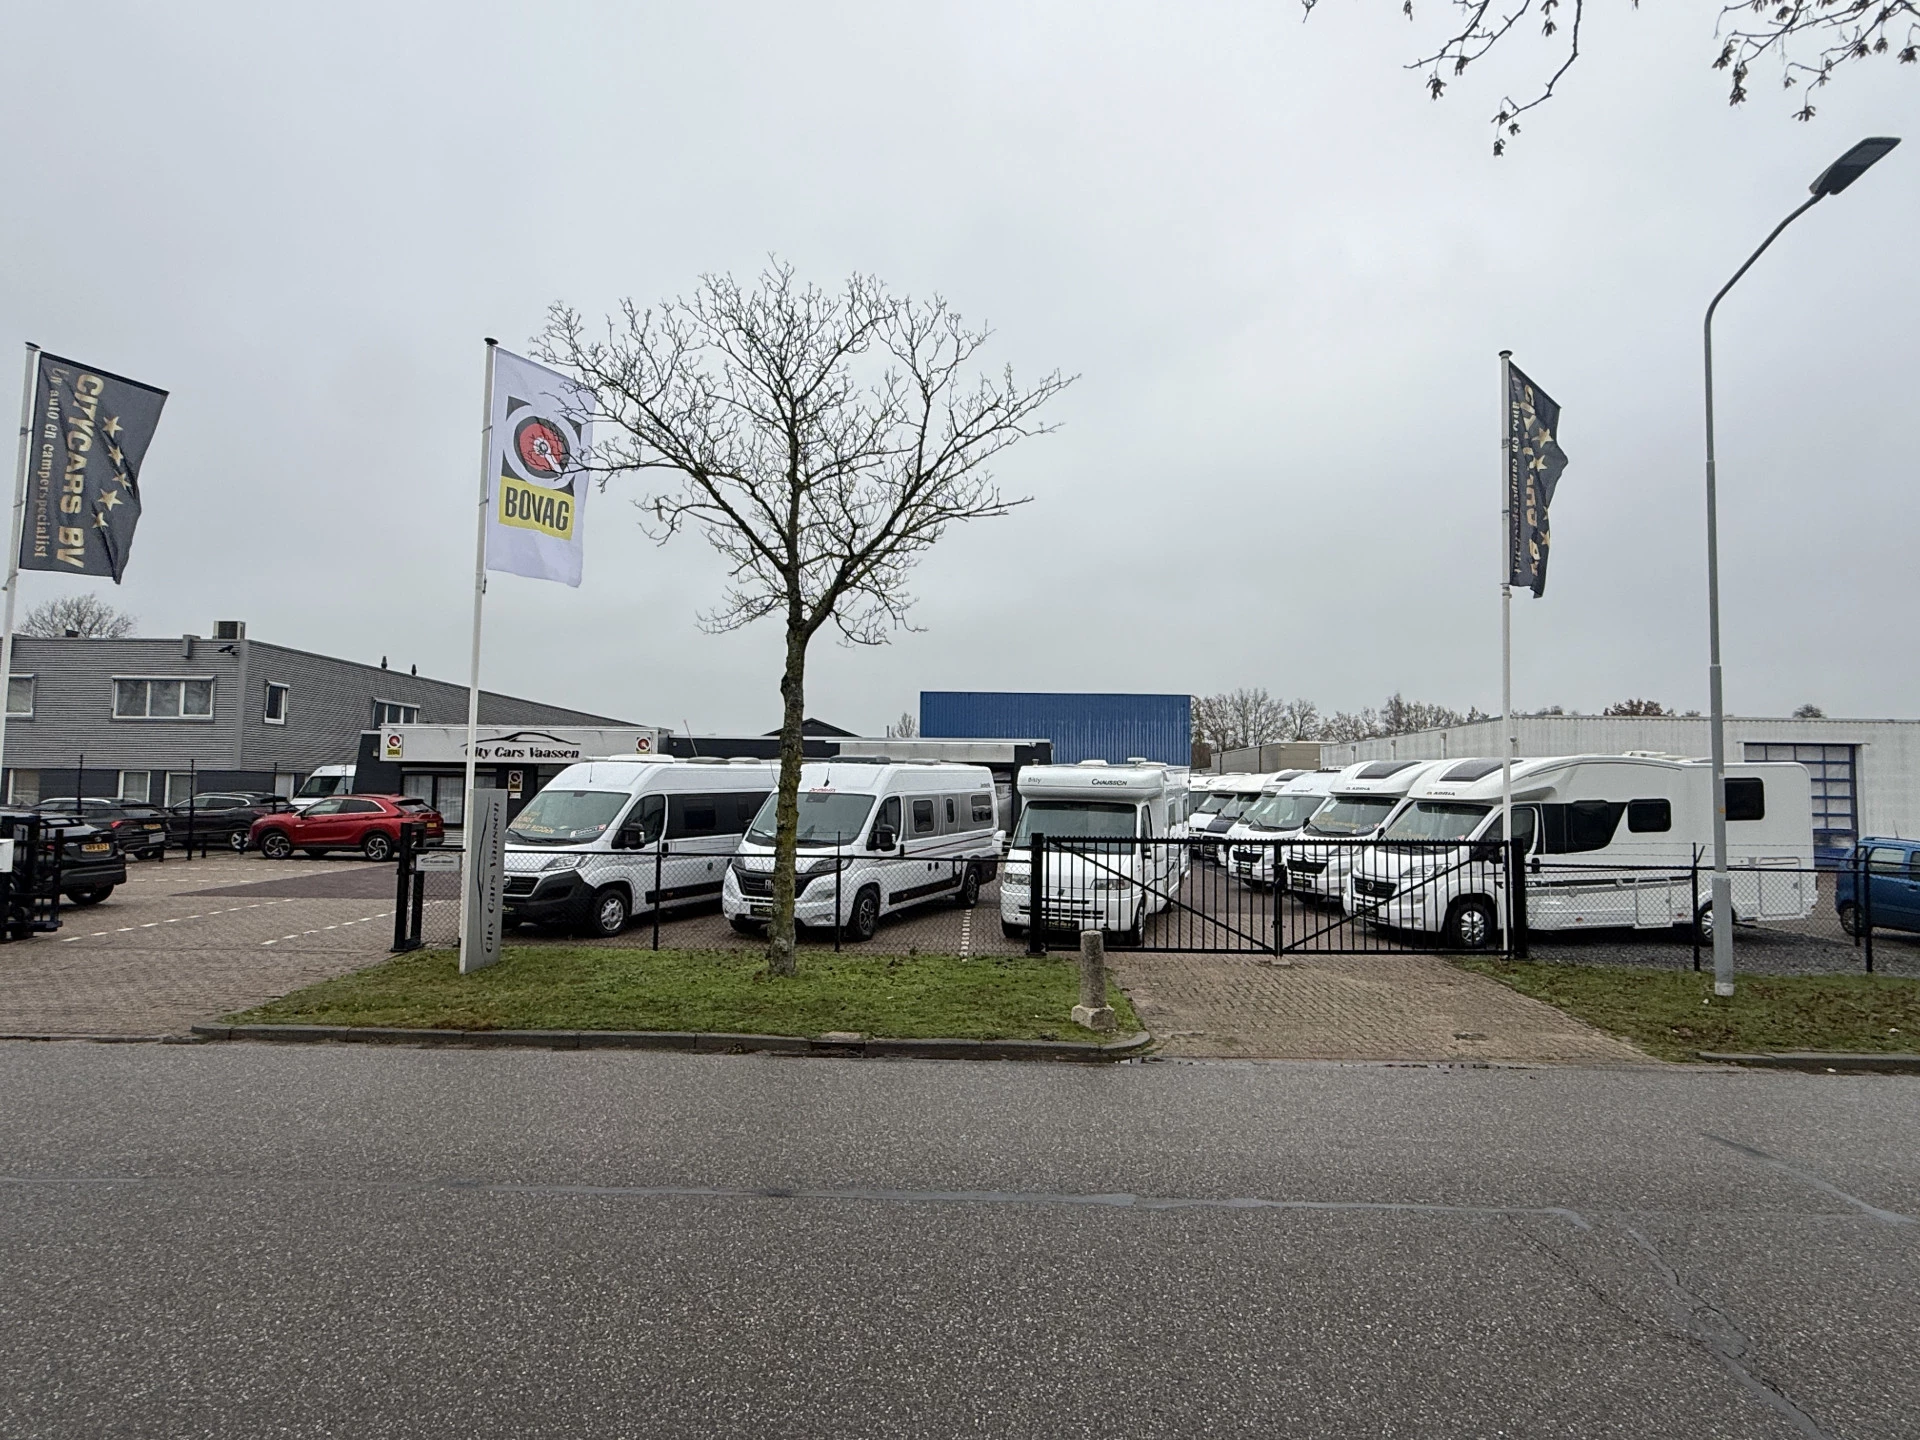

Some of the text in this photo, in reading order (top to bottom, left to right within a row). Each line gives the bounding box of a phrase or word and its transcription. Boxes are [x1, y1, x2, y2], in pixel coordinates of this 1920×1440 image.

[47, 389, 61, 420] auto
[44, 423, 58, 439] en
[56, 374, 104, 568] CITYCARS BV
[34, 443, 55, 558] camperspecialist
[504, 486, 570, 531] BOVAG
[494, 746, 525, 758] Cars
[529, 747, 580, 759] Vaassen
[489, 802, 500, 868] Vaassen
[487, 874, 497, 914] Cars
